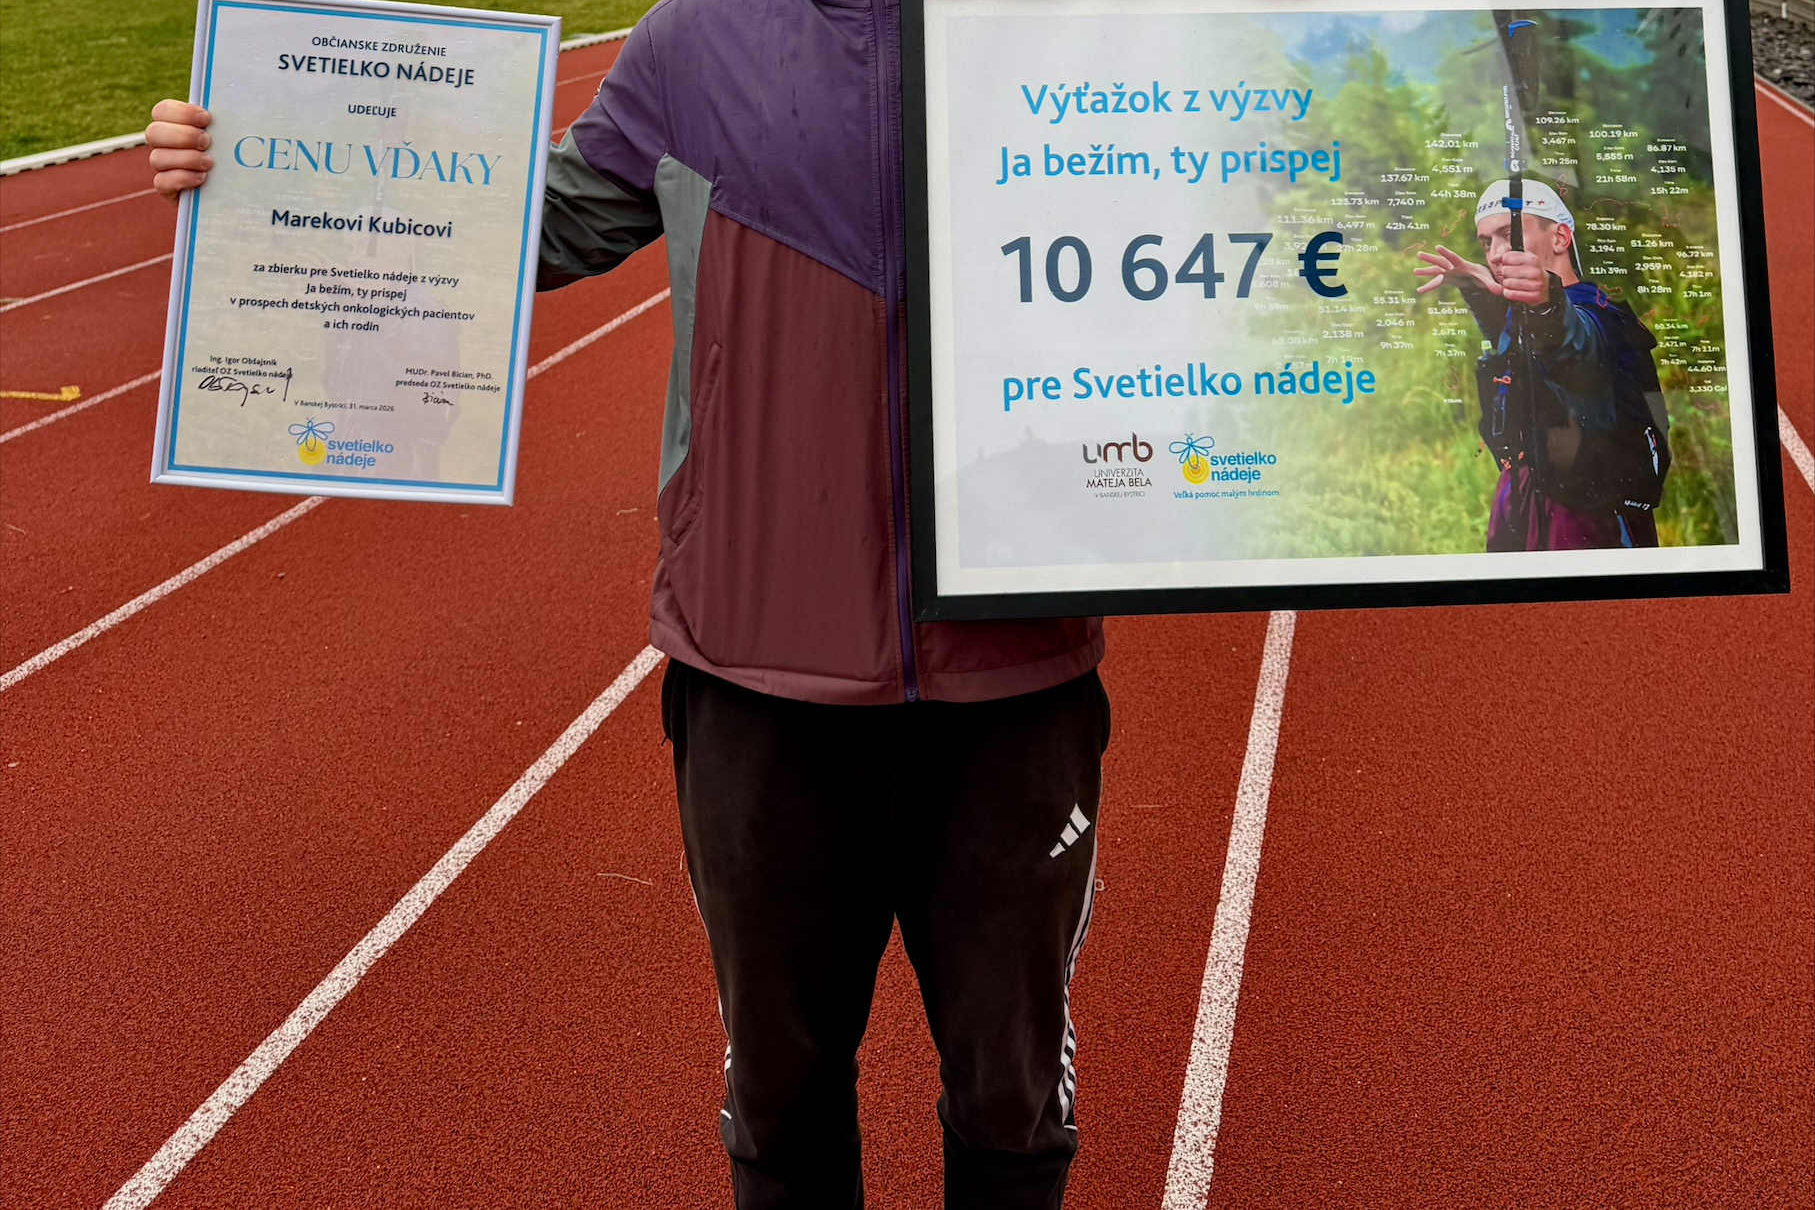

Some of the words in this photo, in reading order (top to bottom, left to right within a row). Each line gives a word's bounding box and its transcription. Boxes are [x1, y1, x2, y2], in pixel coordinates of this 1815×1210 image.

[312, 36, 378, 51] OBČIANSKE
[381, 42, 446, 56] ZDRUŽENIE
[278, 55, 390, 77] SVETIELKO
[397, 61, 474, 88] NÁDEJE
[1021, 80, 1172, 124] Výťažok
[1183, 89, 1200, 112] z
[1209, 82, 1313, 121] výzvy
[348, 104, 396, 118] UDEĽUJE
[1425, 140, 1461, 148] 142.01
[1463, 140, 1478, 148] km
[234, 136, 352, 175] CENU
[363, 141, 502, 186] VĎAKY
[996, 146, 1031, 185] Ja
[1044, 143, 1160, 180] bežím,
[1171, 148, 1209, 184] ty
[1221, 141, 1340, 183] prispej
[1596, 153, 1622, 161] 5,555
[1432, 165, 1461, 174] 4,551
[1430, 190, 1451, 198] 44h
[1453, 190, 1476, 198] 38m
[1387, 198, 1414, 206] 7,740
[272, 210, 362, 232] Marekovi
[369, 218, 452, 238] Kubicovi
[1277, 216, 1315, 224] 111.36
[1317, 216, 1333, 224] km
[1631, 240, 1657, 248] 51.26
[1001, 235, 1092, 303] 10
[1121, 232, 1274, 301] 647
[1298, 231, 1348, 299] €
[253, 264, 265, 272] za
[268, 263, 307, 275] zbierku
[310, 269, 327, 278] pre
[331, 267, 379, 280] Svetielko
[383, 272, 418, 283] nádeje
[421, 275, 426, 283] z
[429, 274, 459, 287] výzvy
[305, 284, 316, 294] Ja
[320, 284, 353, 297] bežím,
[357, 287, 368, 297] ty
[371, 288, 407, 301] prispej
[239, 297, 288, 309] prospech
[292, 299, 340, 312] detských
[343, 303, 420, 318] onkologických
[423, 310, 475, 321] pacientov
[333, 320, 348, 329] ich
[351, 322, 379, 331] rodín
[406, 368, 429, 376] MUDr.
[452, 371, 474, 379] Bician,
[477, 385, 500, 393] nádeje
[1003, 373, 1061, 411] pre
[1073, 364, 1242, 400] Svetielko
[1254, 360, 1376, 404] nádeje
[300, 401, 322, 409] Banskej
[328, 440, 394, 453] svetielko
[1083, 432, 1153, 463] umb
[327, 452, 376, 469] nádeje
[1210, 452, 1277, 466] svetielko
[1094, 468, 1144, 478] UNIVERZITA
[1212, 467, 1261, 483] nádeje
[1087, 478, 1126, 488] MATEJA
[1129, 478, 1152, 486] BELA
[1174, 491, 1193, 499] Veľká
[1222, 490, 1246, 498] malým
